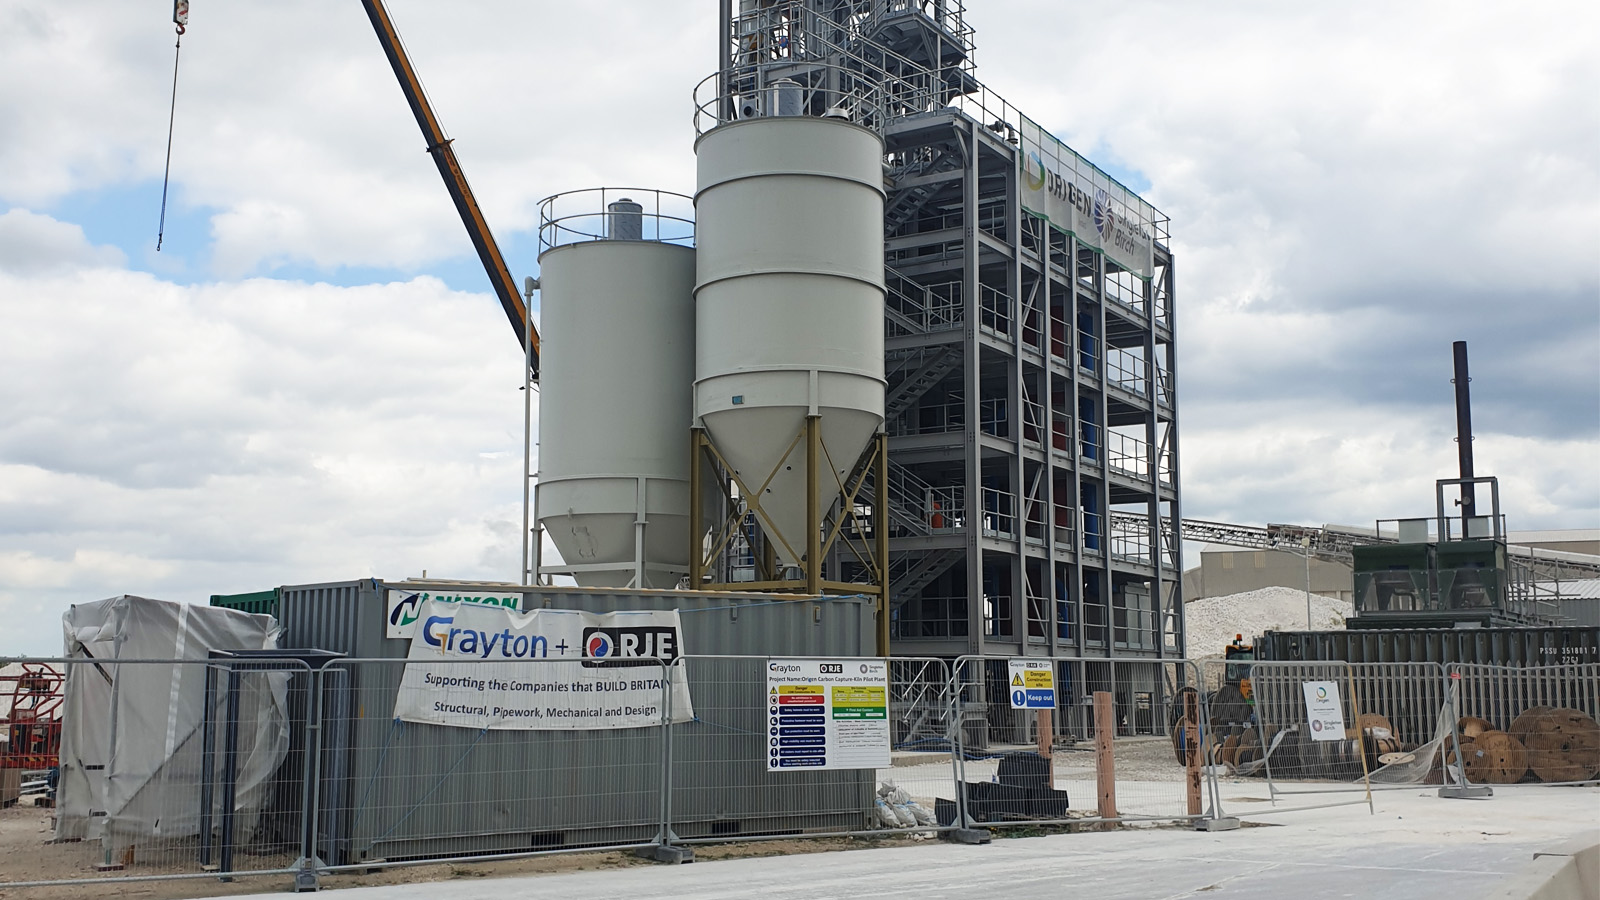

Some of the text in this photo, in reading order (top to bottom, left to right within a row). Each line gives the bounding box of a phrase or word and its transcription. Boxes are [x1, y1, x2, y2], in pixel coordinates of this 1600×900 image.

[1115, 229, 1134, 256] Birch
[423, 615, 548, 658] Grayton
[770, 663, 801, 674] Grayton
[425, 673, 485, 691] Supporting
[488, 679, 508, 691] the
[510, 681, 569, 694] Companies
[572, 682, 593, 692] that
[596, 681, 627, 692] BUILD
[434, 701, 657, 719] Structural, Pipework, Mechanical and Design
